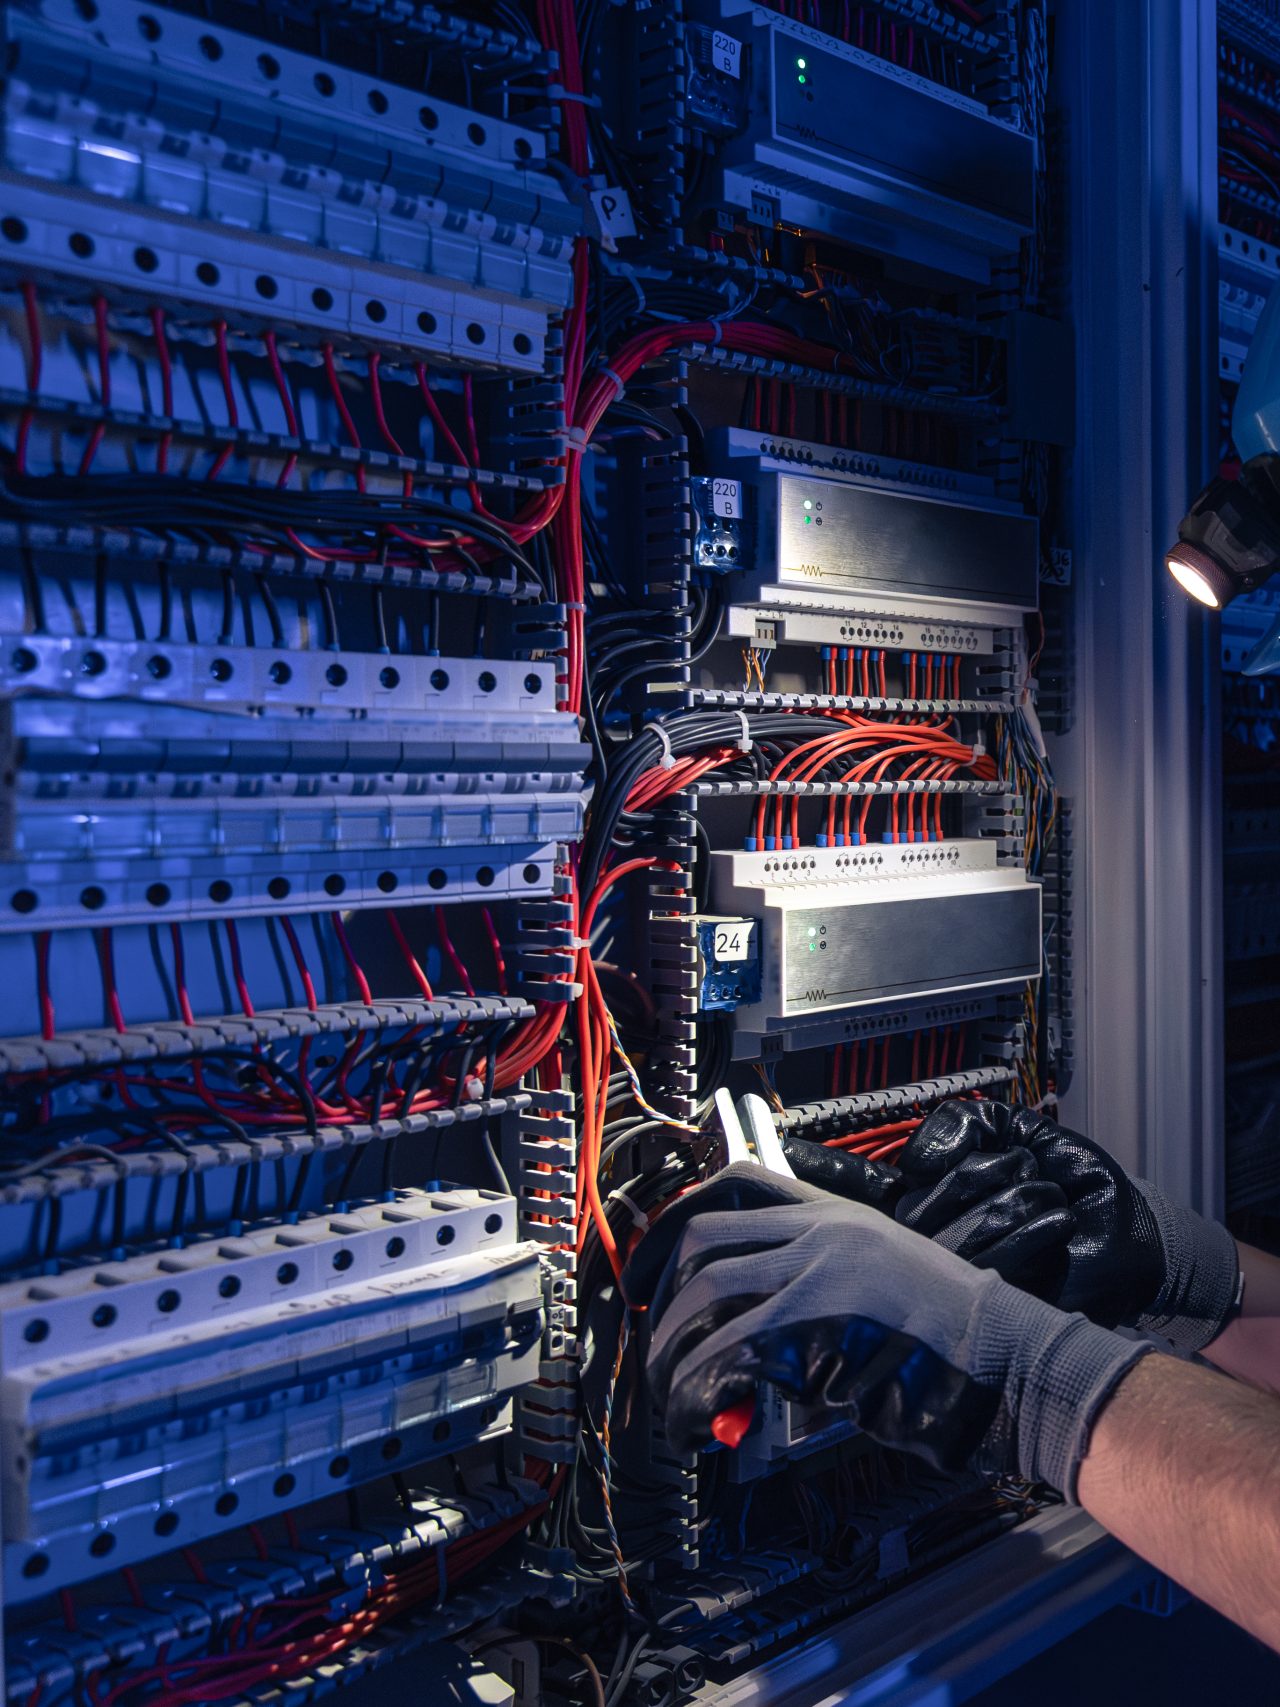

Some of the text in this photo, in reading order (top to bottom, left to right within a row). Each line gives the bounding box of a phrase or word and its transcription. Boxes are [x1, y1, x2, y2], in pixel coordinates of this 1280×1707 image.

[714, 34, 736, 55] 220
[724, 57, 732, 72] B
[714, 482, 737, 497] 220
[725, 502, 733, 515] B
